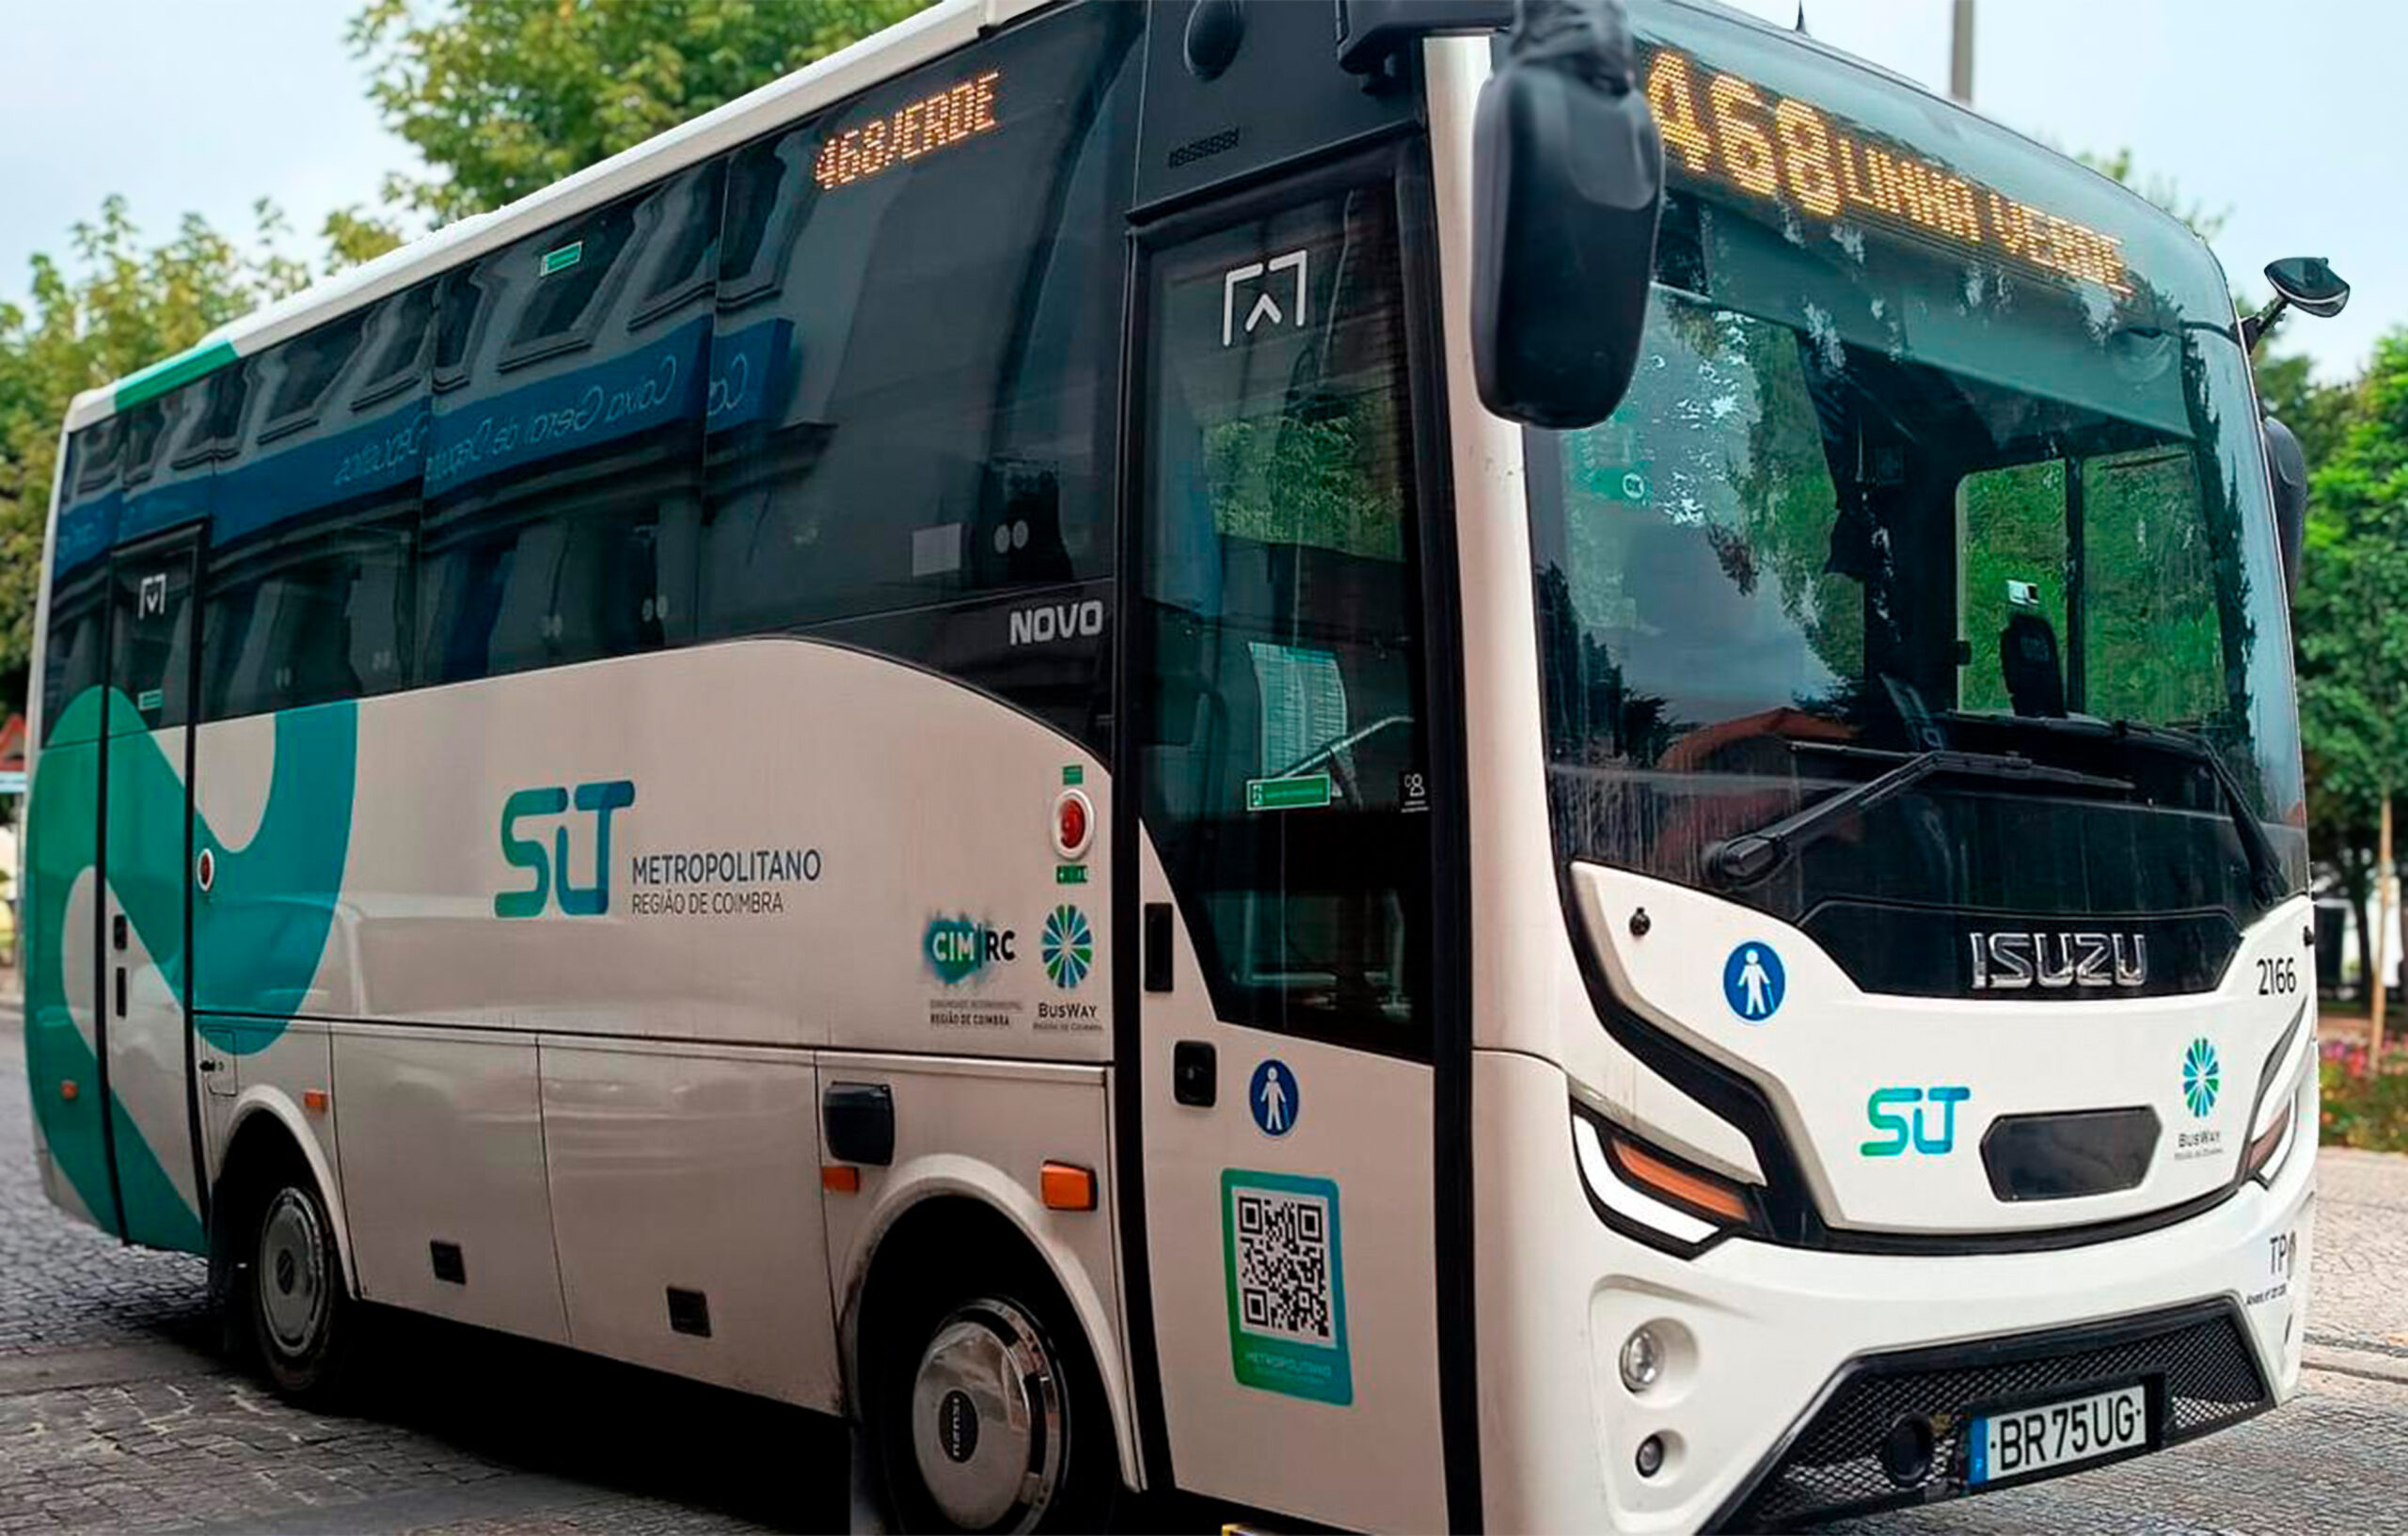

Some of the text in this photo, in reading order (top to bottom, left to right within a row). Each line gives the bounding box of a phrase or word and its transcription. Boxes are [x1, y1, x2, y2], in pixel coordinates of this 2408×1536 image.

[1648, 53, 2136, 295] 468 LINHA VERDE
[1010, 600, 1103, 646] NOVO
[631, 848, 823, 884] METROPOLITANO
[631, 889, 784, 915] REGIÃO DE COIMBRA
[1970, 932, 2149, 990] ISUZU
[2257, 958, 2296, 996] 2166
